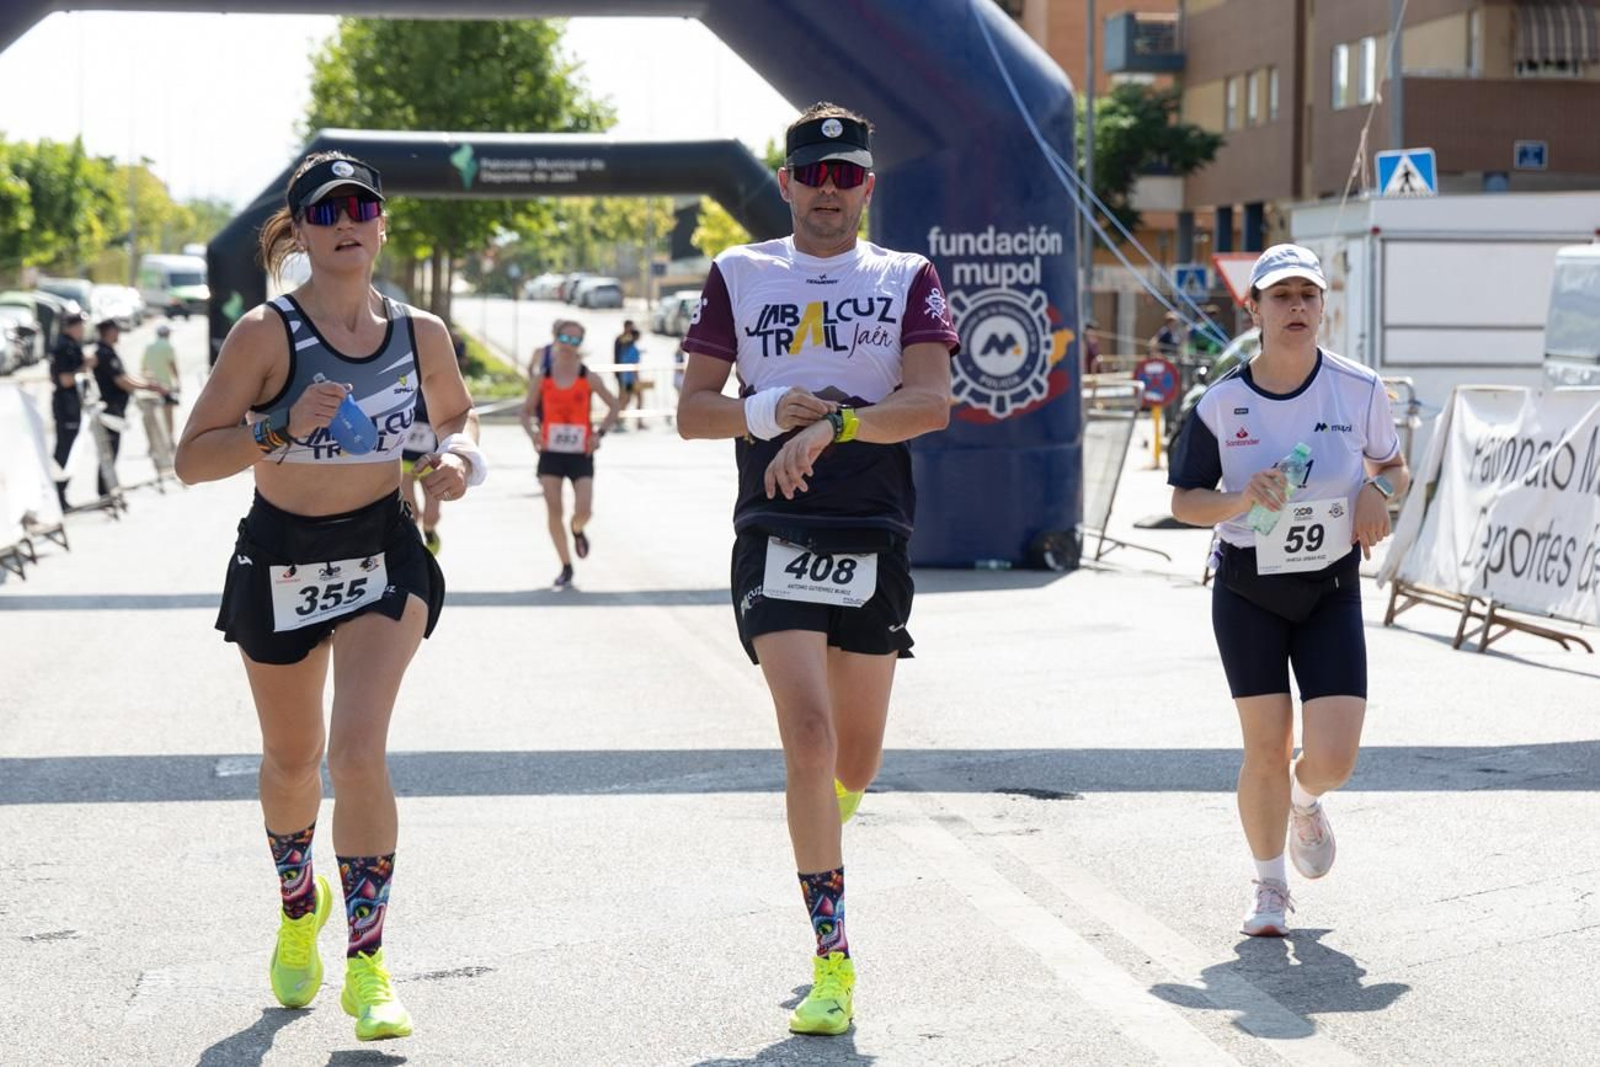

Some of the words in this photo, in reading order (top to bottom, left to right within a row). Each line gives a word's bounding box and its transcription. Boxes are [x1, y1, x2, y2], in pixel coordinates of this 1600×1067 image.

[927, 224, 1063, 256] fundación
[952, 256, 1042, 289] mupol
[745, 296, 897, 337] JABALCUZ
[760, 322, 849, 358] TRAIL
[847, 323, 893, 359] Jaén
[1226, 439, 1260, 447] Santander
[1331, 424, 1352, 434] mupol
[1284, 523, 1325, 554] 59
[784, 551, 858, 586] 408
[295, 577, 369, 616] 355
